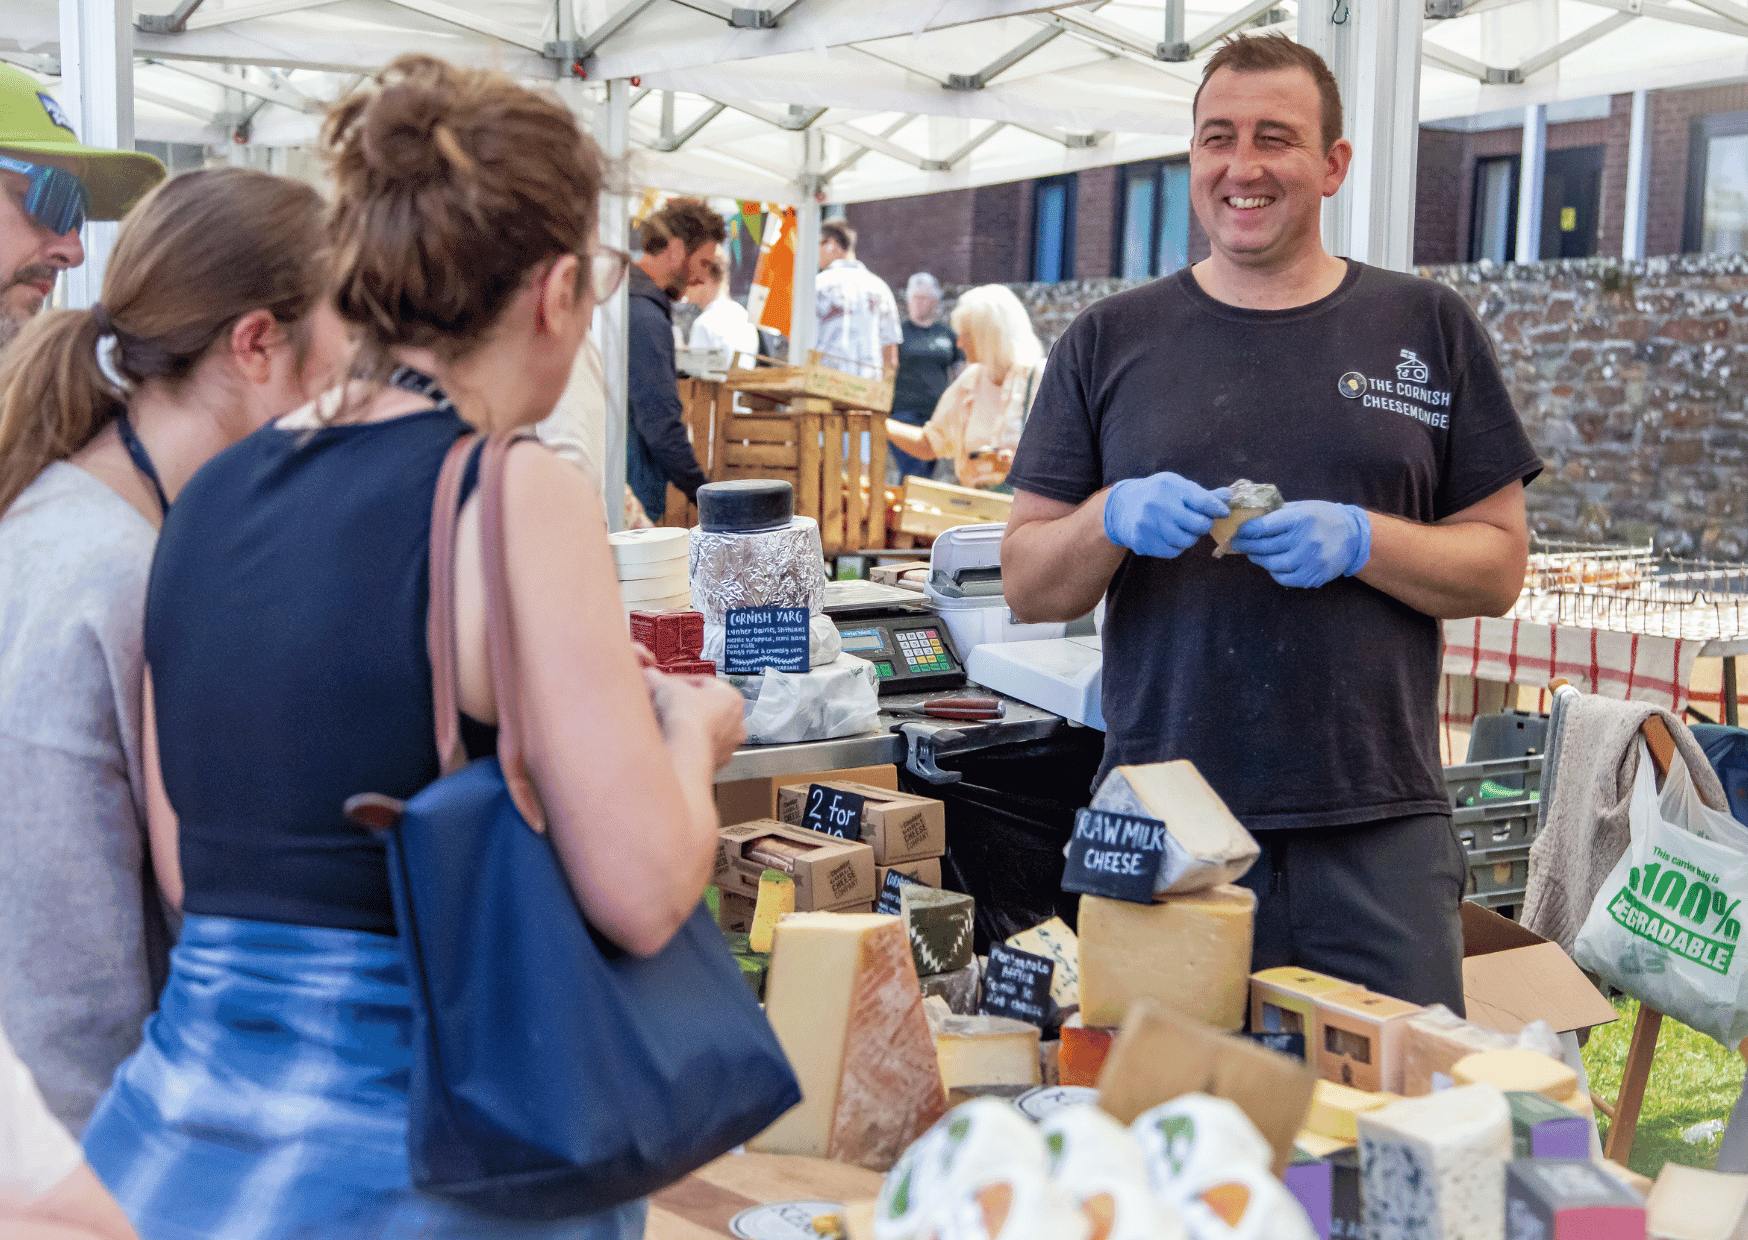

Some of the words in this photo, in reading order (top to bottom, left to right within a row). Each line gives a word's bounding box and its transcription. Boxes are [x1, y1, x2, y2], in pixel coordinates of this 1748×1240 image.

[1368, 378, 1394, 393] THE
[1396, 382, 1451, 406] CORNISH
[1362, 394, 1450, 429] CHEESEMONGE
[776, 610, 803, 623] YARG
[808, 788, 824, 819] 2
[904, 823, 928, 843] CHEESE
[1076, 811, 1122, 846] RAW
[1120, 821, 1166, 851] MILK
[1083, 848, 1143, 875] CHEESE
[1653, 845, 1671, 862] This
[1670, 856, 1696, 873] carrier
[1696, 867, 1711, 882] bag
[1711, 873, 1720, 884] is
[832, 871, 857, 892] CHEESE
[1641, 862, 1742, 943] 100%
